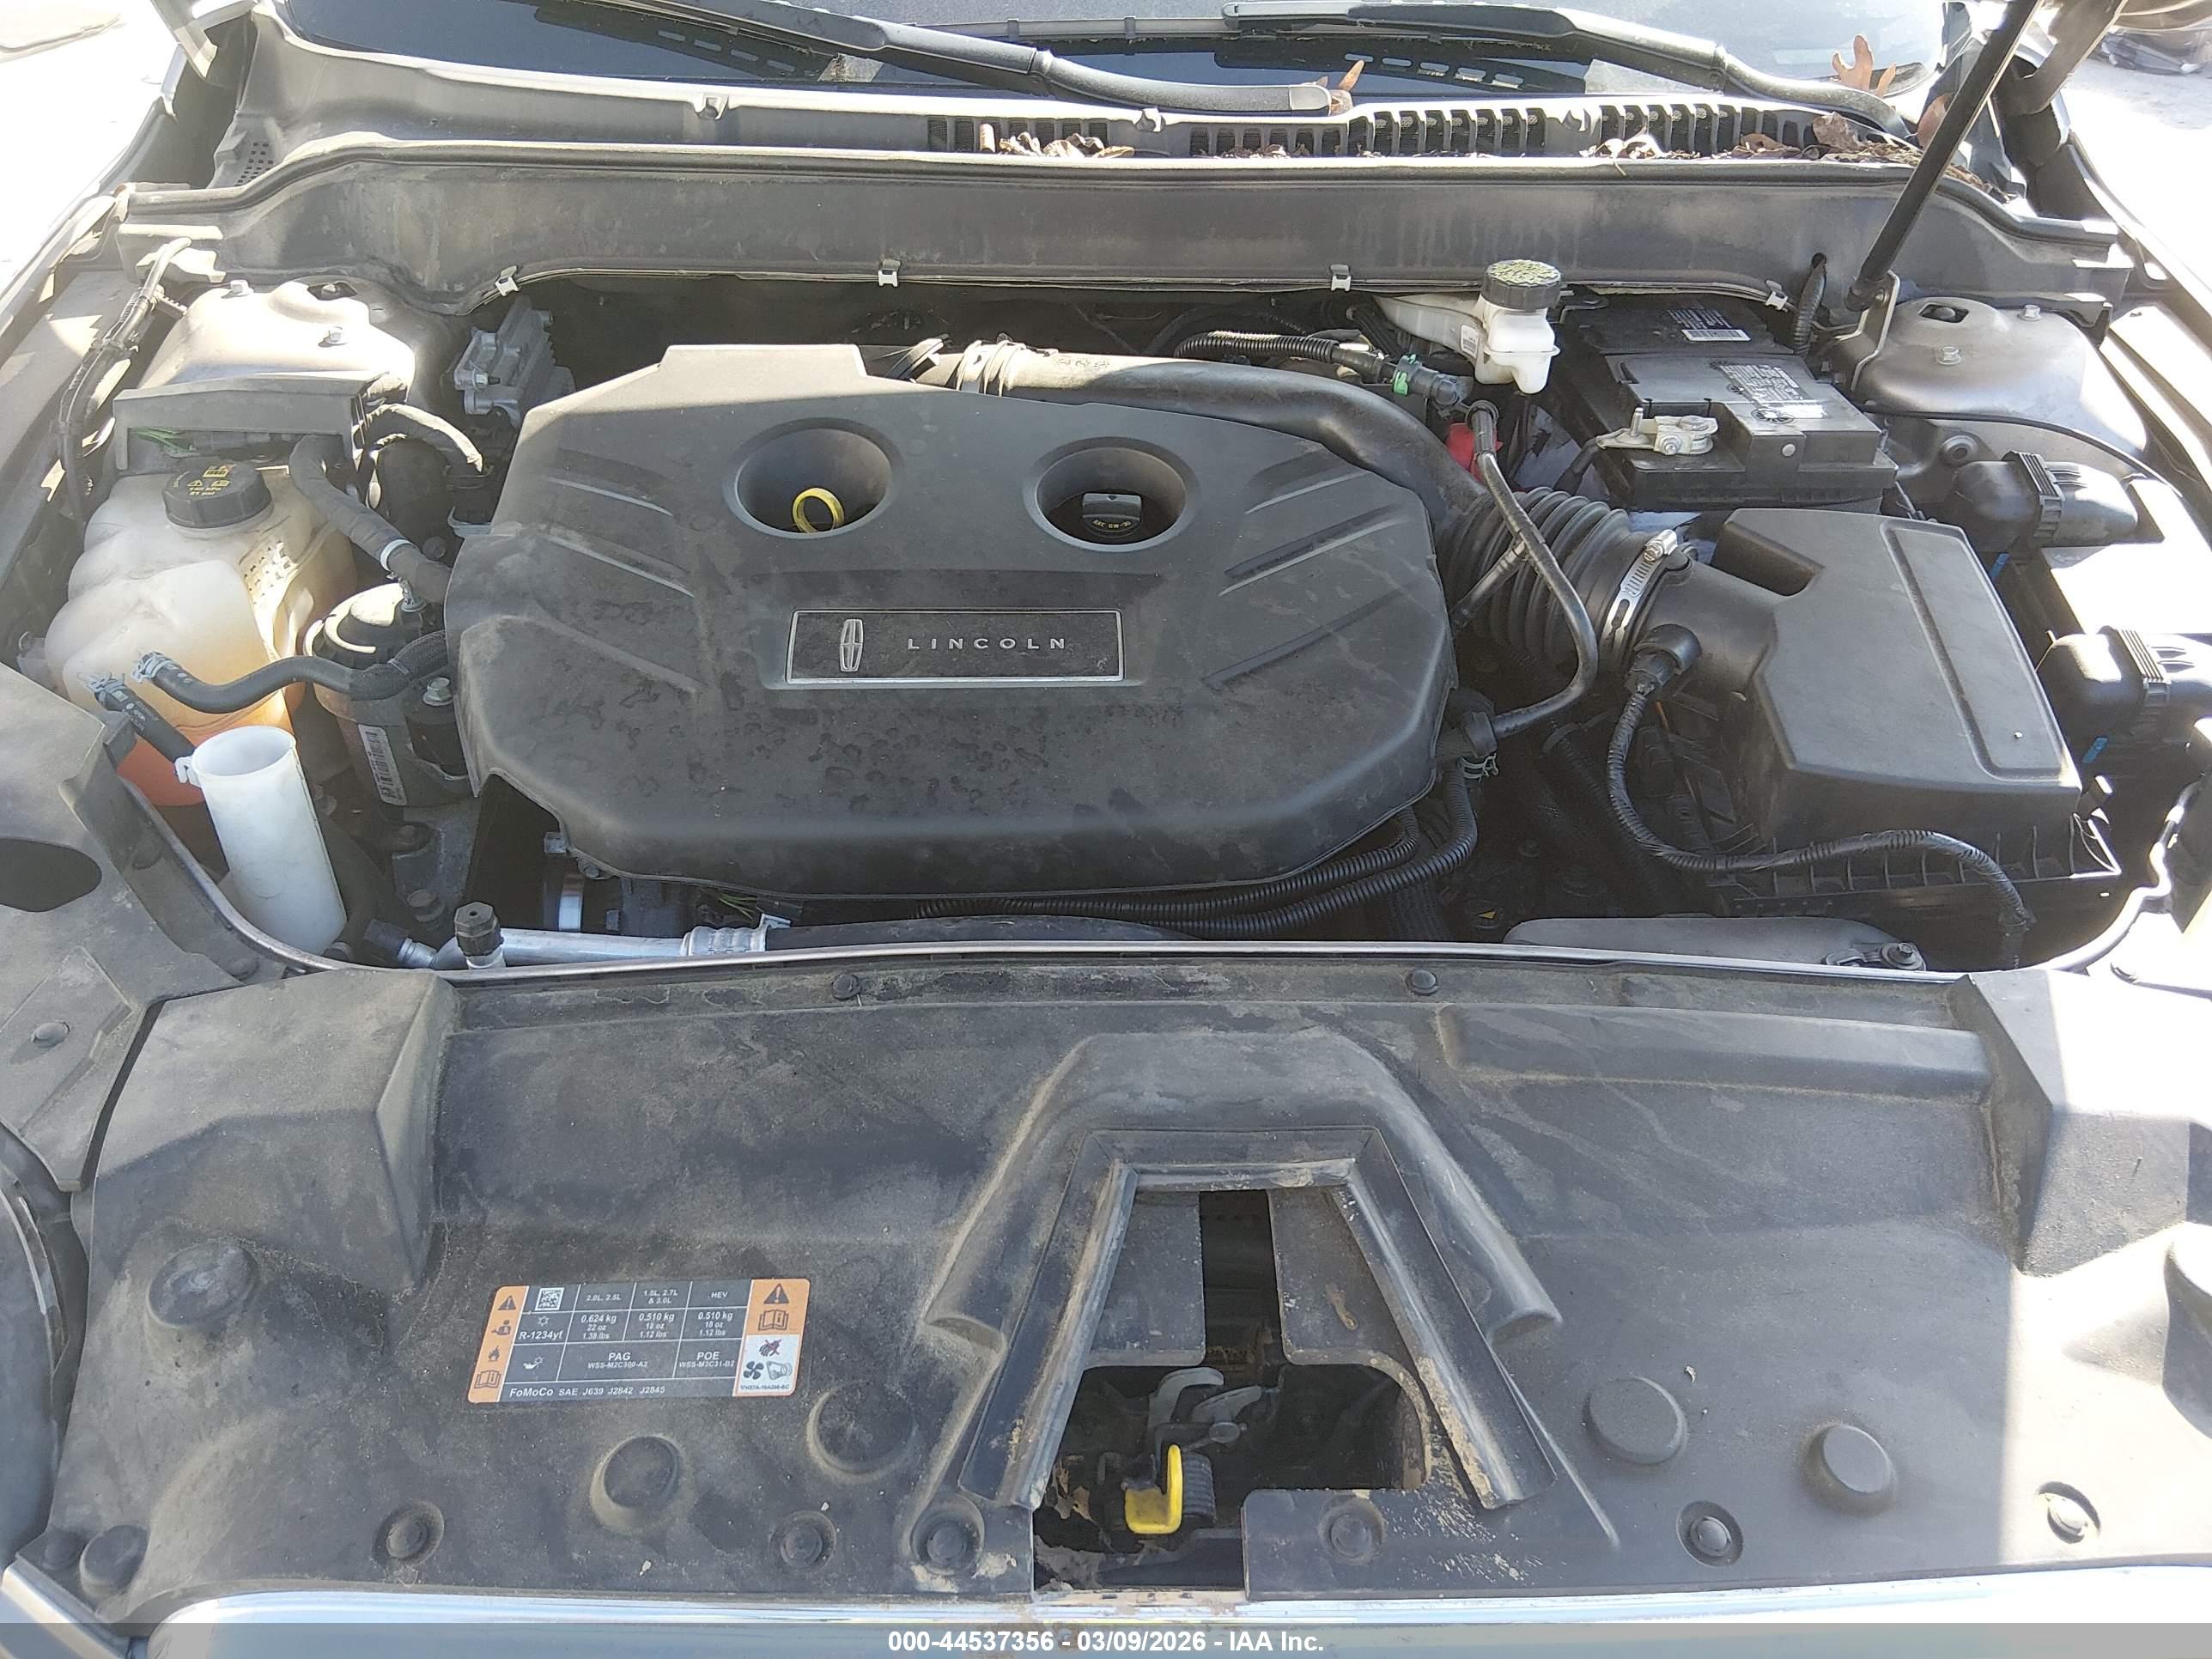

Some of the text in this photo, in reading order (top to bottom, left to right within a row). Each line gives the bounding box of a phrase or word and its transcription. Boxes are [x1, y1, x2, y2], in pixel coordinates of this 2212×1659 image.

[908, 638, 1066, 650] LINCOLN
[580, 1314, 617, 1324] 0.624 kg
[663, 1313, 675, 1322] kg
[722, 1311, 733, 1321] kg
[519, 1331, 563, 1340] R-1234yf
[608, 1352, 631, 1361] PAG
[696, 1351, 720, 1360] POE
[510, 1388, 554, 1397] FoMoCo
